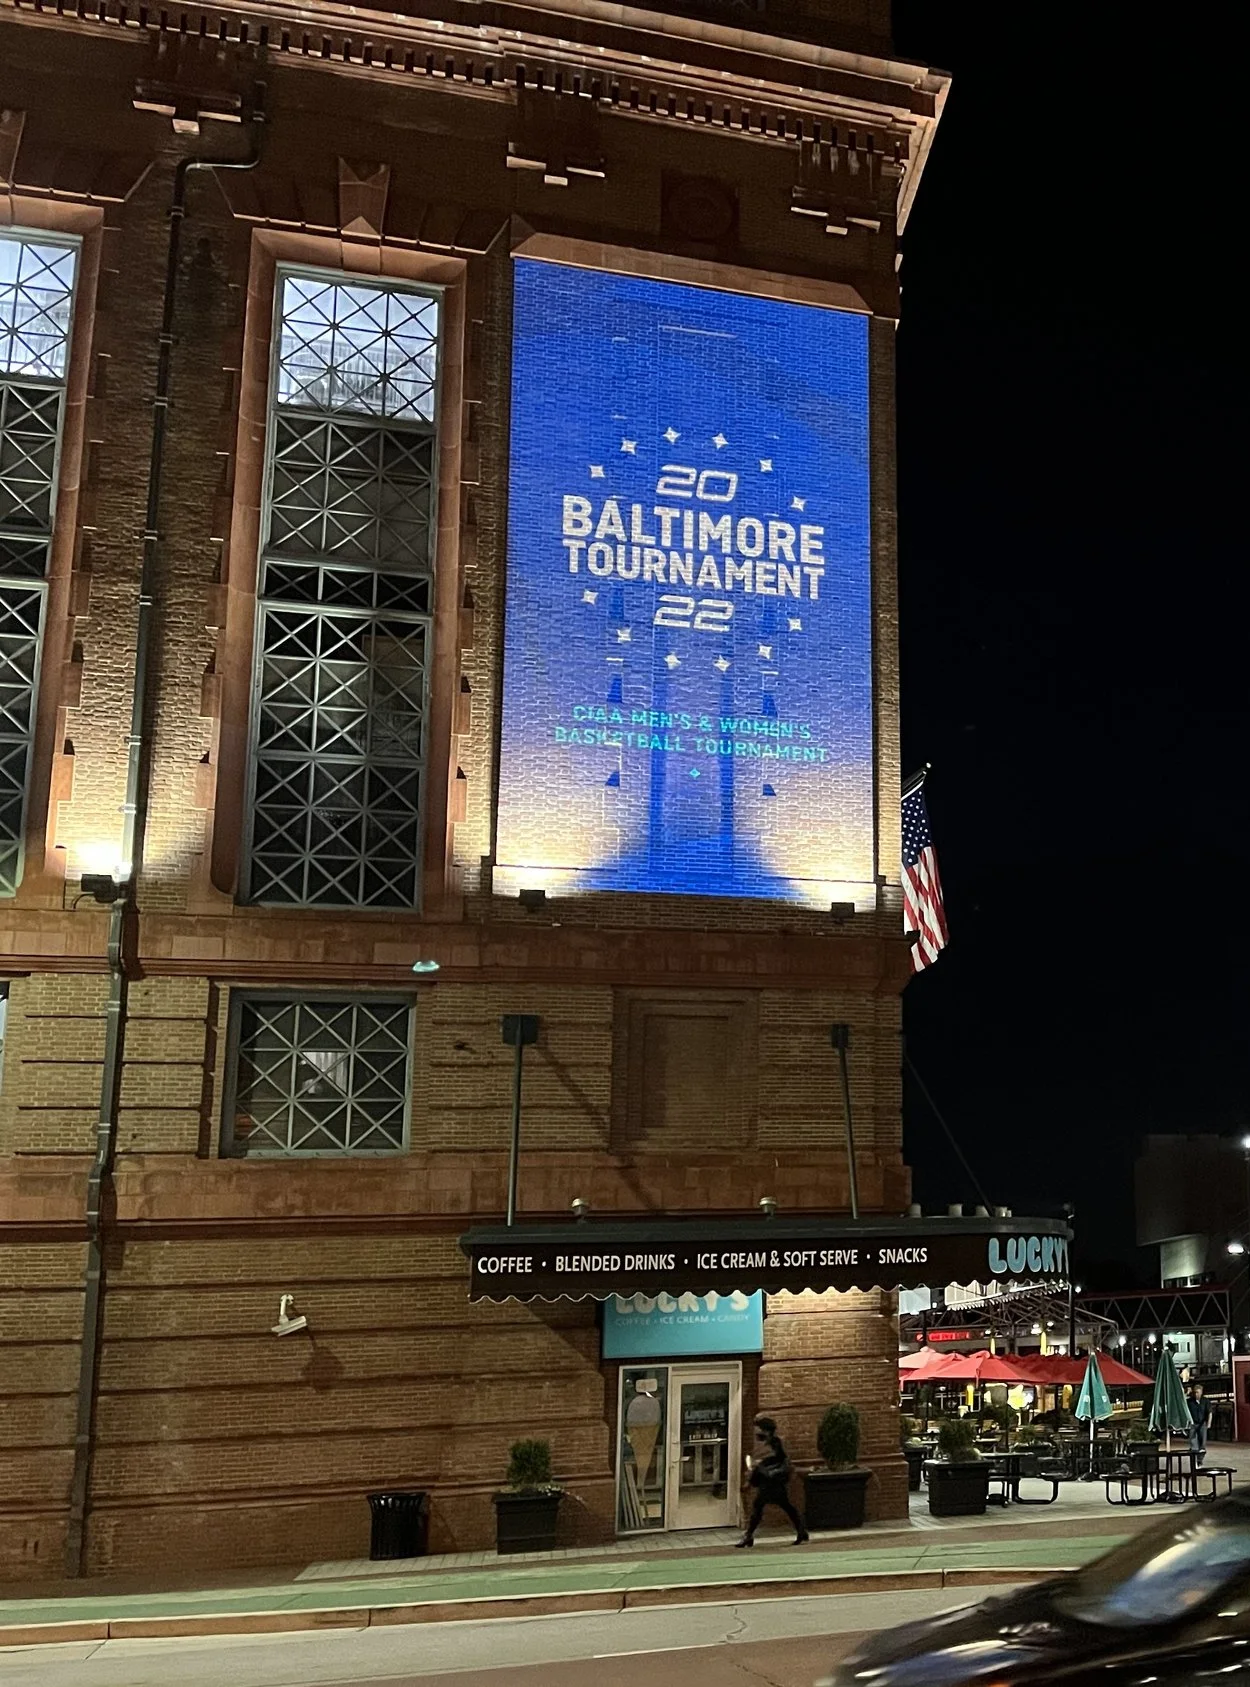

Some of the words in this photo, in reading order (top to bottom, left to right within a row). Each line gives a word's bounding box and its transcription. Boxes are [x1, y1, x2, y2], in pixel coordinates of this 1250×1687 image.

[656, 464, 738, 502] 20
[562, 495, 825, 565] BALTIMORE
[562, 539, 825, 599] TOURNAMENT
[653, 594, 735, 632] 22
[631, 710, 692, 731] MEN'S
[700, 716, 712, 733] &
[720, 717, 812, 740] WOMEN'S
[554, 727, 686, 752] BASKETBALL
[695, 734, 828, 763] TOURNAMENT
[477, 1256, 533, 1274] COFFEE
[555, 1255, 621, 1272] BLENDED
[624, 1254, 676, 1271] DRINKS
[697, 1253, 718, 1269] ICE
[721, 1252, 766, 1269] CREAM
[769, 1250, 781, 1268] &
[783, 1250, 817, 1267] SOFT
[819, 1249, 859, 1266] SERVE
[878, 1247, 928, 1264] SNACKS
[659, 1314, 674, 1325] ICE
[676, 1314, 710, 1324] CREAM
[717, 1313, 749, 1323] CANDY
